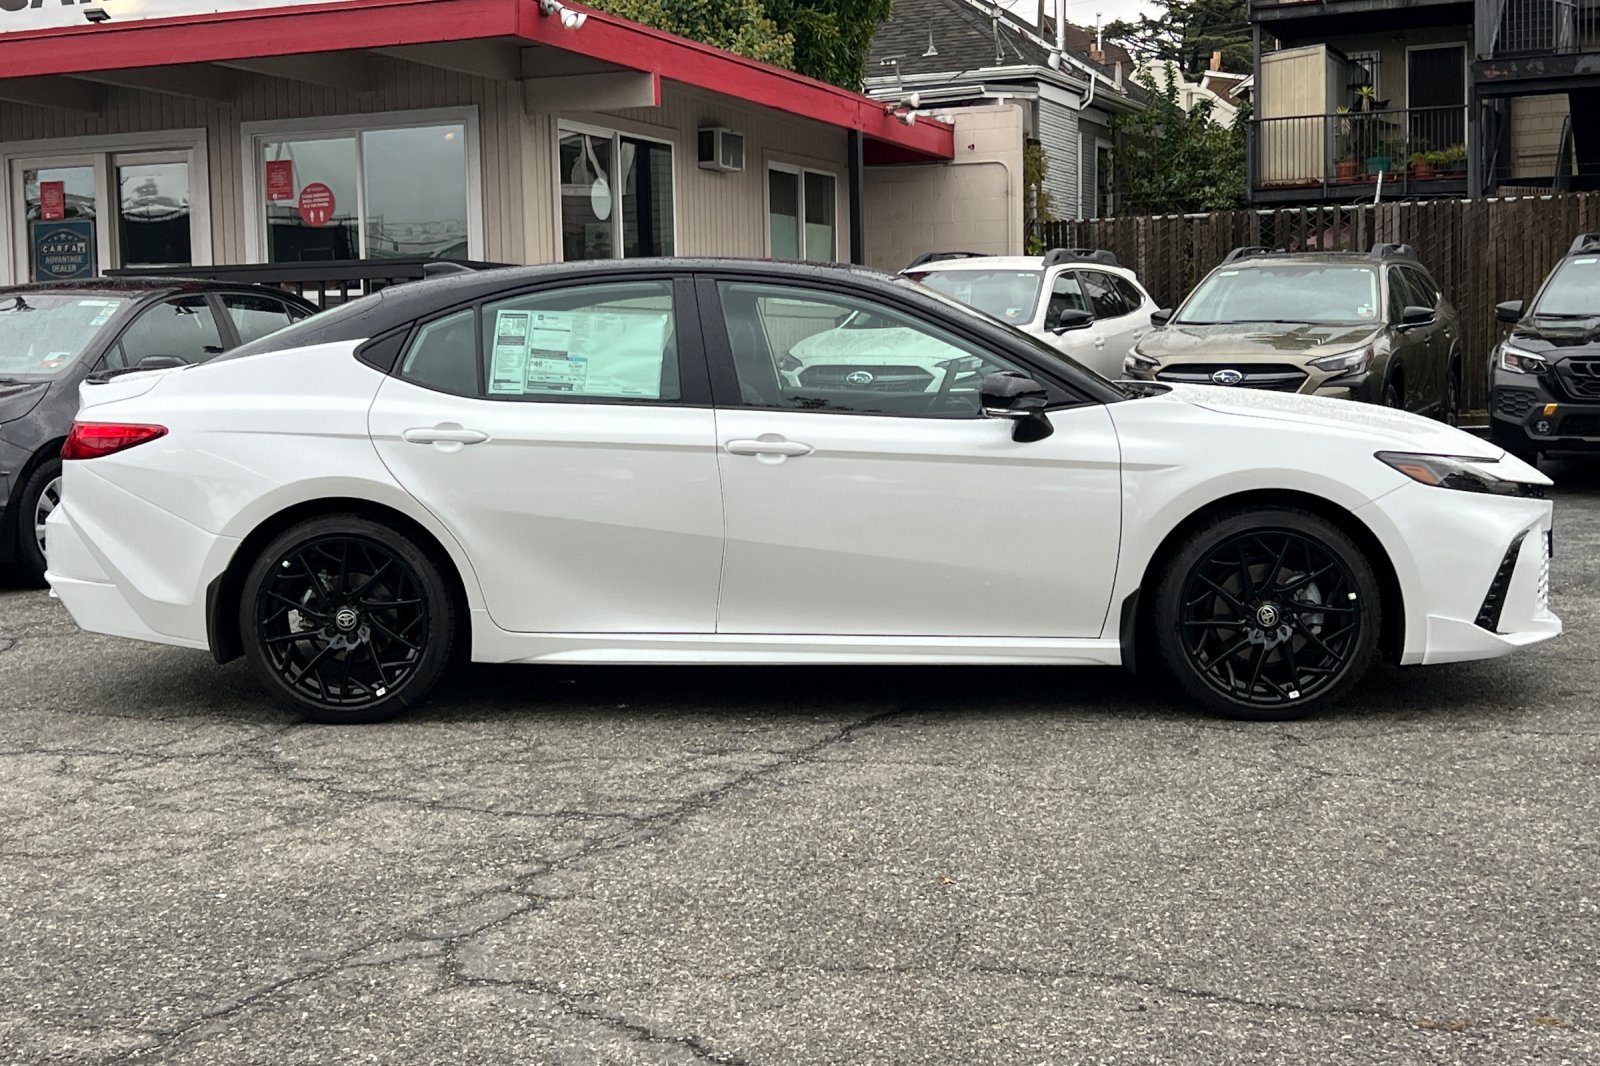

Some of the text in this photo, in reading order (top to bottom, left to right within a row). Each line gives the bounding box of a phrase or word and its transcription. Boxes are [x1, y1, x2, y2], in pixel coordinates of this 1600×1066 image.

[42, 243, 86, 253] CARFAX
[45, 255, 82, 264] ADVANTAGE
[51, 264, 77, 273] DEALER
